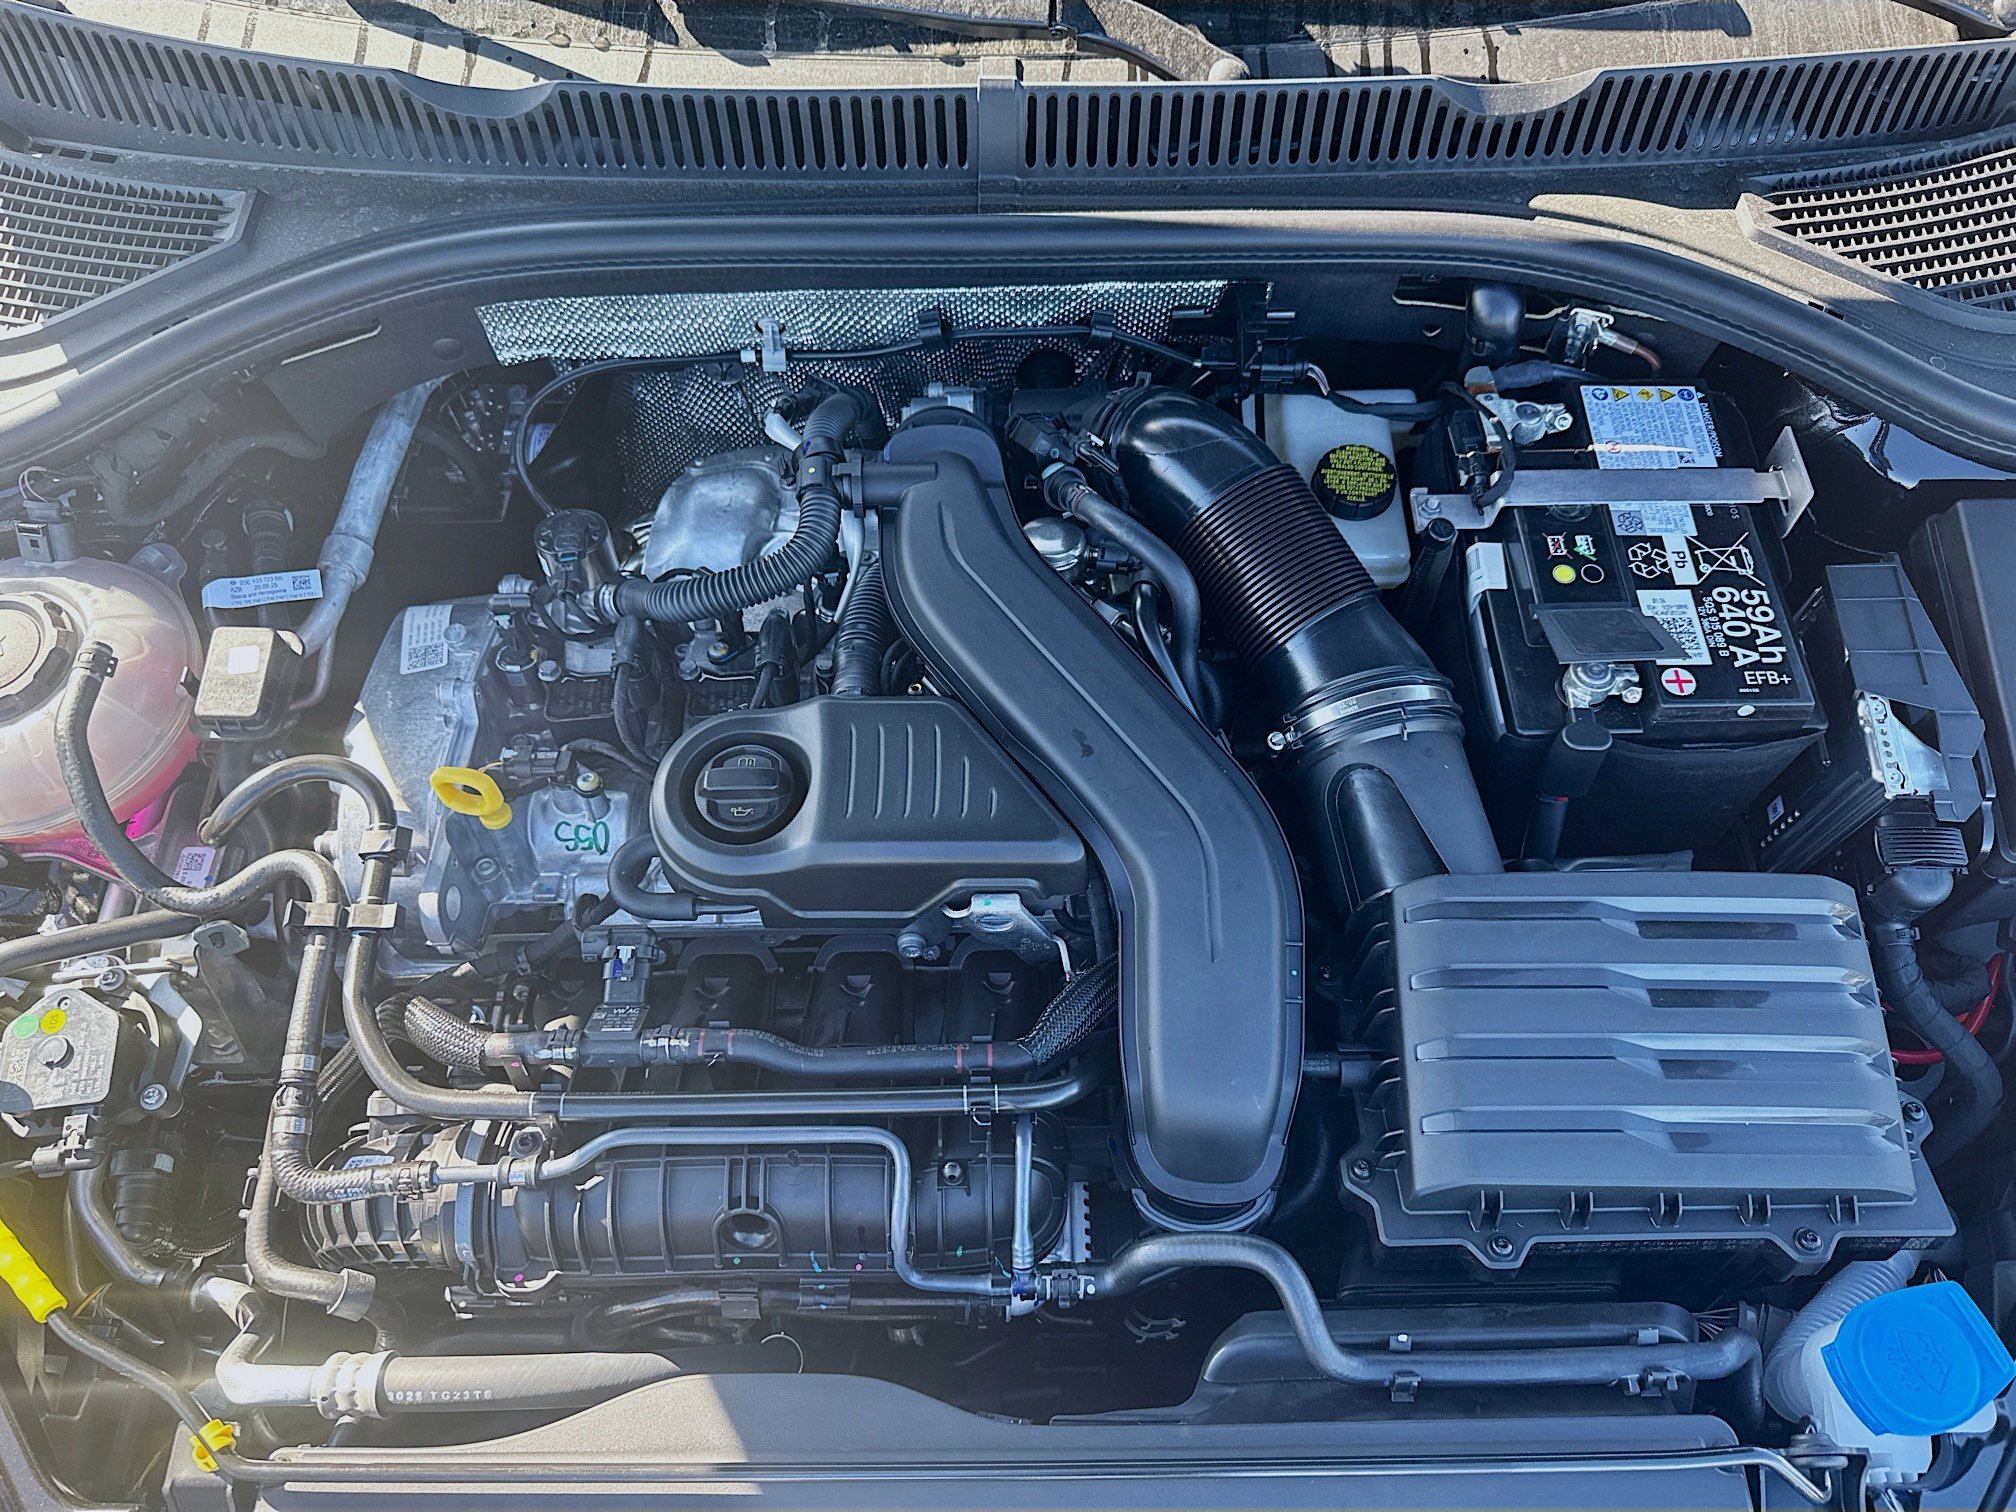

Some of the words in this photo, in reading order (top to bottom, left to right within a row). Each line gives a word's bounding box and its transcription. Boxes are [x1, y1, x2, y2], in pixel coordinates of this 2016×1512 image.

[1700, 402, 1723, 458] DANGER/POISON
[1671, 550, 1688, 569] Pb
[1712, 586, 1751, 637] 640
[1709, 616, 1721, 630] 915
[1740, 589, 1787, 664] 59Ah
[1713, 632, 1727, 648] 089
[1728, 645, 1760, 668] A
[1743, 670, 1792, 685] EFB+
